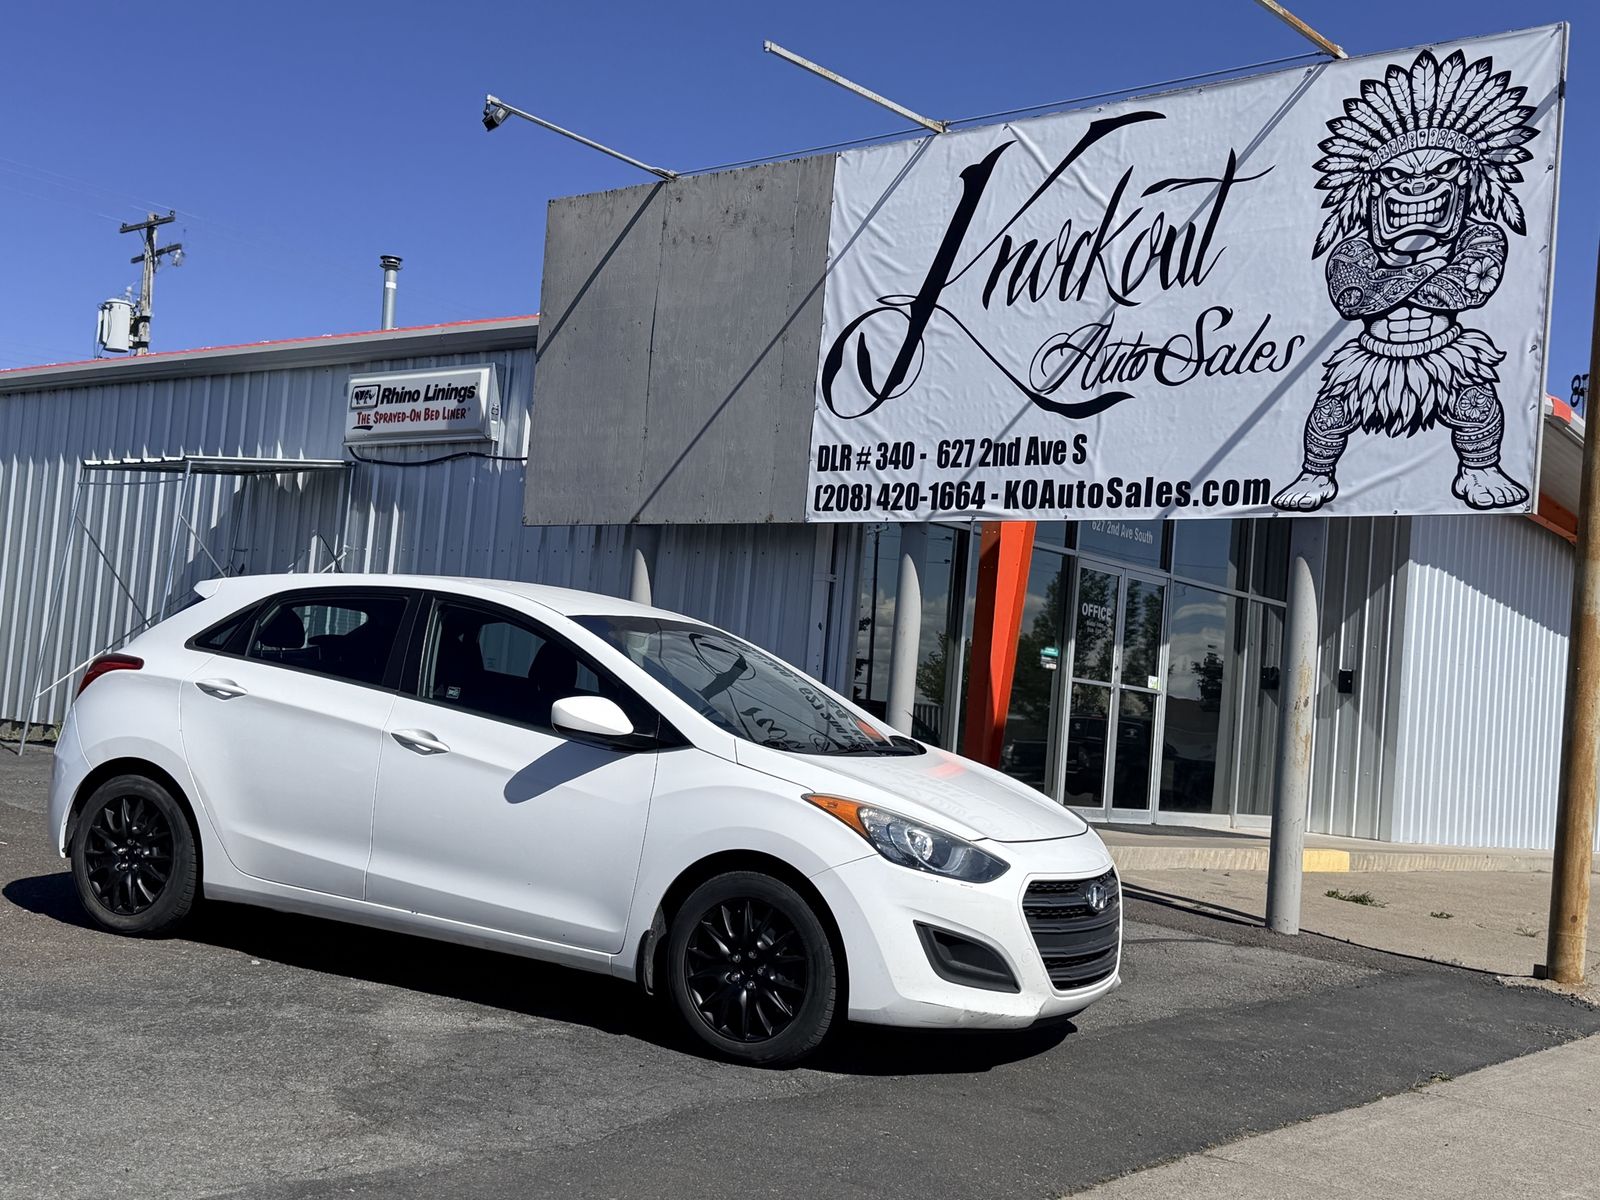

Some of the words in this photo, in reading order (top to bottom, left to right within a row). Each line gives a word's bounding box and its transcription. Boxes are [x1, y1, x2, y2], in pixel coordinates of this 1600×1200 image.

[821, 110, 1275, 420] Knockout
[1029, 310, 1151, 395] Auto
[1143, 305, 1305, 387] Sales
[380, 385, 421, 405] Rhino
[423, 382, 476, 403] Linings
[357, 411, 371, 425] THE
[424, 407, 440, 421] BED
[442, 406, 467, 421] LINER
[816, 444, 852, 472] DLR
[856, 446, 872, 471] #
[875, 441, 915, 470] 340
[936, 438, 976, 468] 627
[978, 437, 1022, 467] 2nd
[1024, 436, 1067, 466] Ave
[1072, 433, 1088, 465] S
[813, 484, 873, 512] (208)
[876, 480, 986, 511] 420-1664
[1003, 476, 1272, 510] KOAutoSales.com
[1091, 520, 1106, 533] 627
[1106, 520, 1121, 537] 2nd
[1120, 523, 1134, 540] Ave
[1134, 527, 1153, 544] South
[1082, 602, 1112, 621] OFFICE
